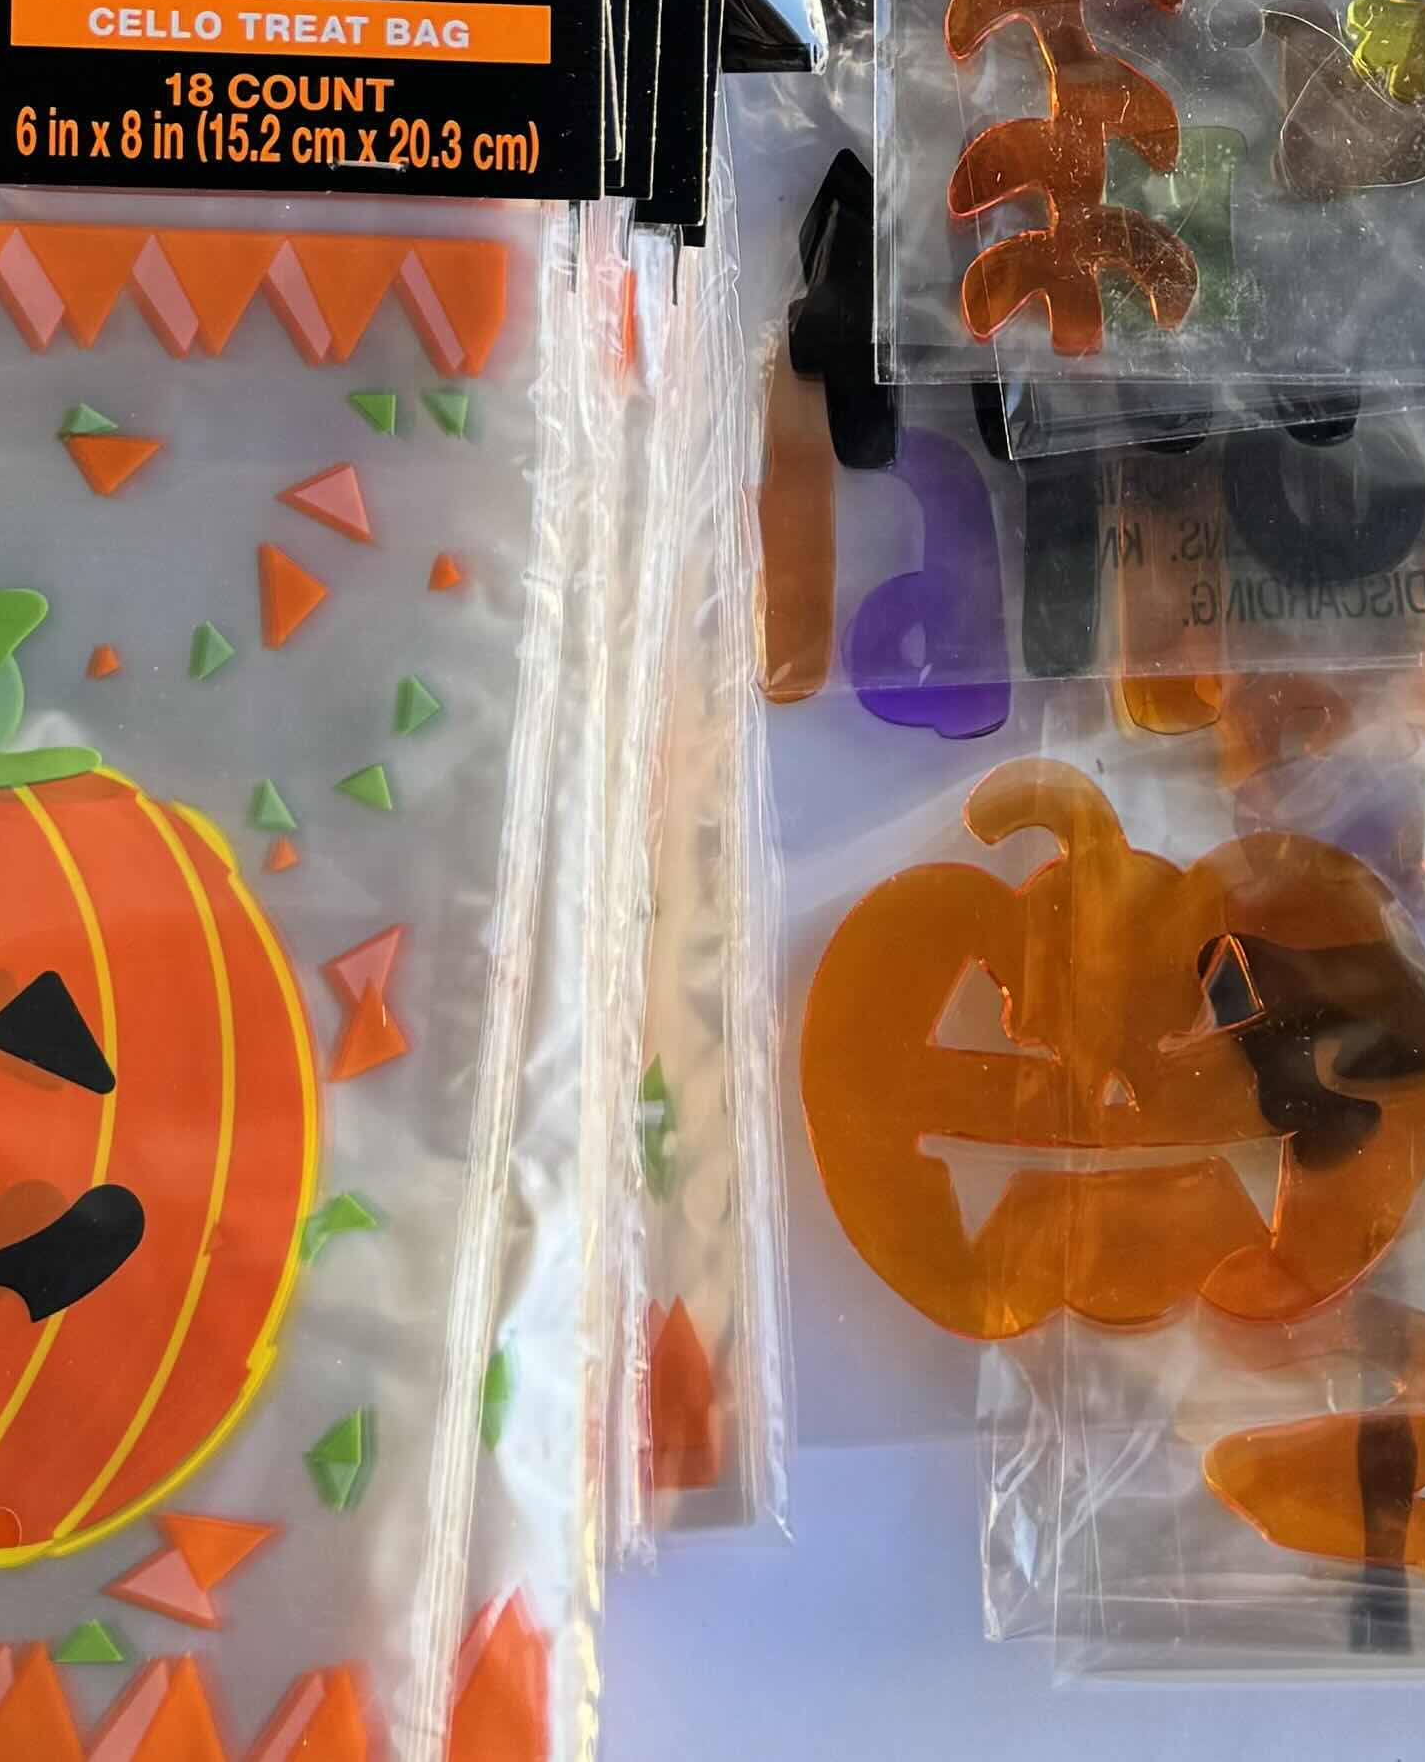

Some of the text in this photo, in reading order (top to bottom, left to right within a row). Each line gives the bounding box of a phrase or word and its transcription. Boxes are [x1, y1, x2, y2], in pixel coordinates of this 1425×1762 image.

[88, 7, 471, 49] CELLO TREAT BAG
[165, 73, 395, 113] 18 COUNT
[16, 106, 540, 175] 6 in x 8 in (15.2 cm x 20.3 cm)
